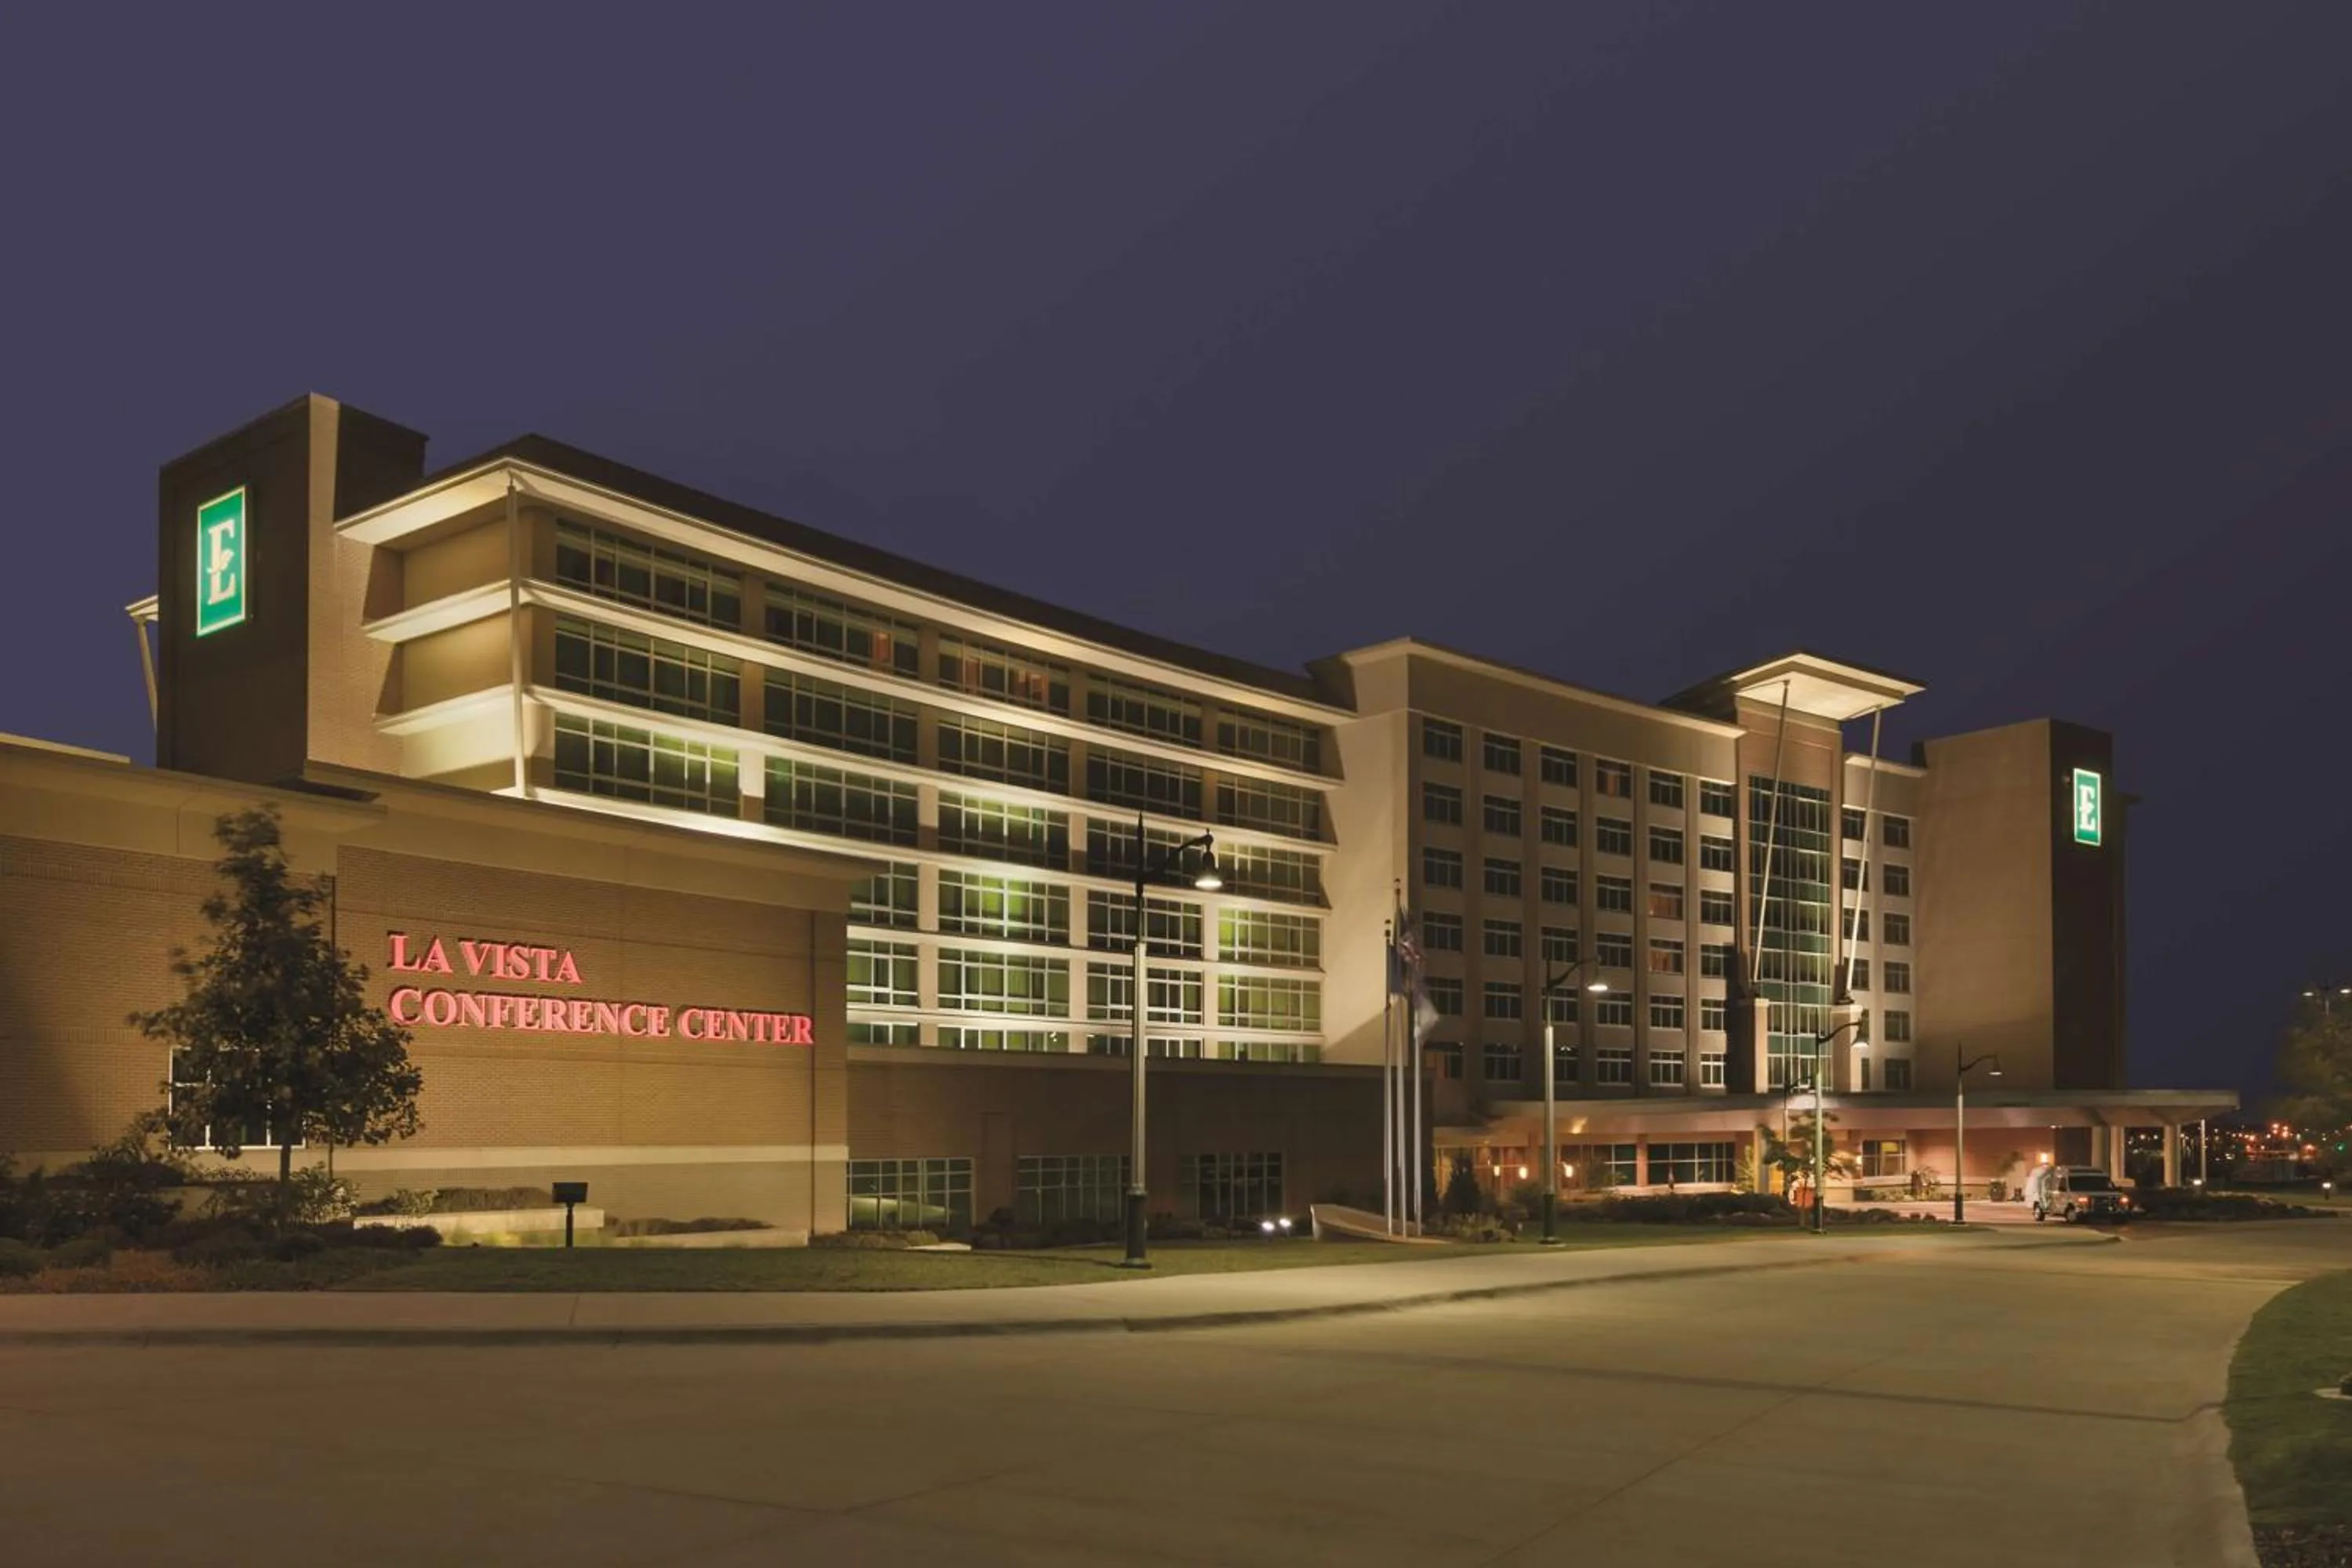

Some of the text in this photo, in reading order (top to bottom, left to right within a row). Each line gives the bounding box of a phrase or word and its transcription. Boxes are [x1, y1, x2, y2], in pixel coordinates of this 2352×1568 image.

[206, 518, 235, 605] E
[388, 932, 583, 984] LA VISTA
[389, 987, 814, 1044] CONFERENCE CENTER
